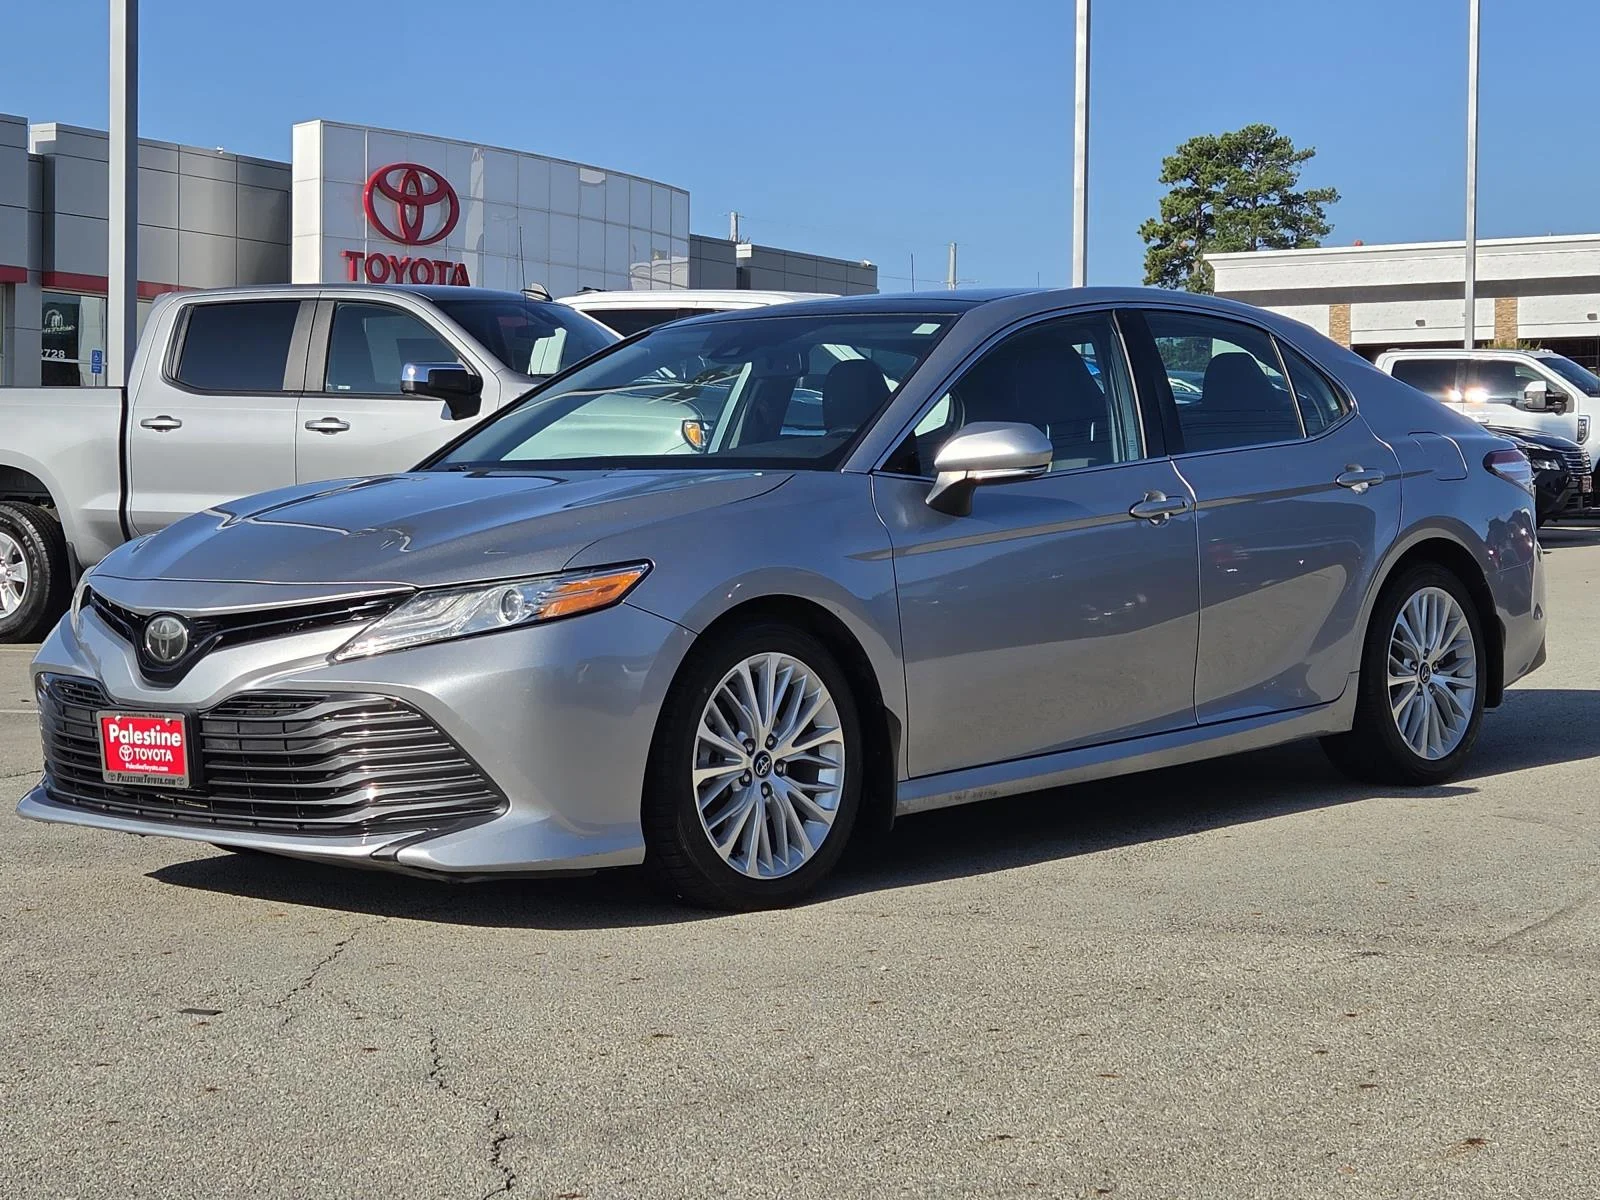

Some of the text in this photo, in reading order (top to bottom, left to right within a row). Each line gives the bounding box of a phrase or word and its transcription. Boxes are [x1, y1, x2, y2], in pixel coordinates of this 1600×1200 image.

[341, 250, 471, 287] TOYOTA
[22, 535, 39, 592] NEXEN
[109, 724, 181, 747] Palestine
[134, 748, 173, 762] TOYOTA
